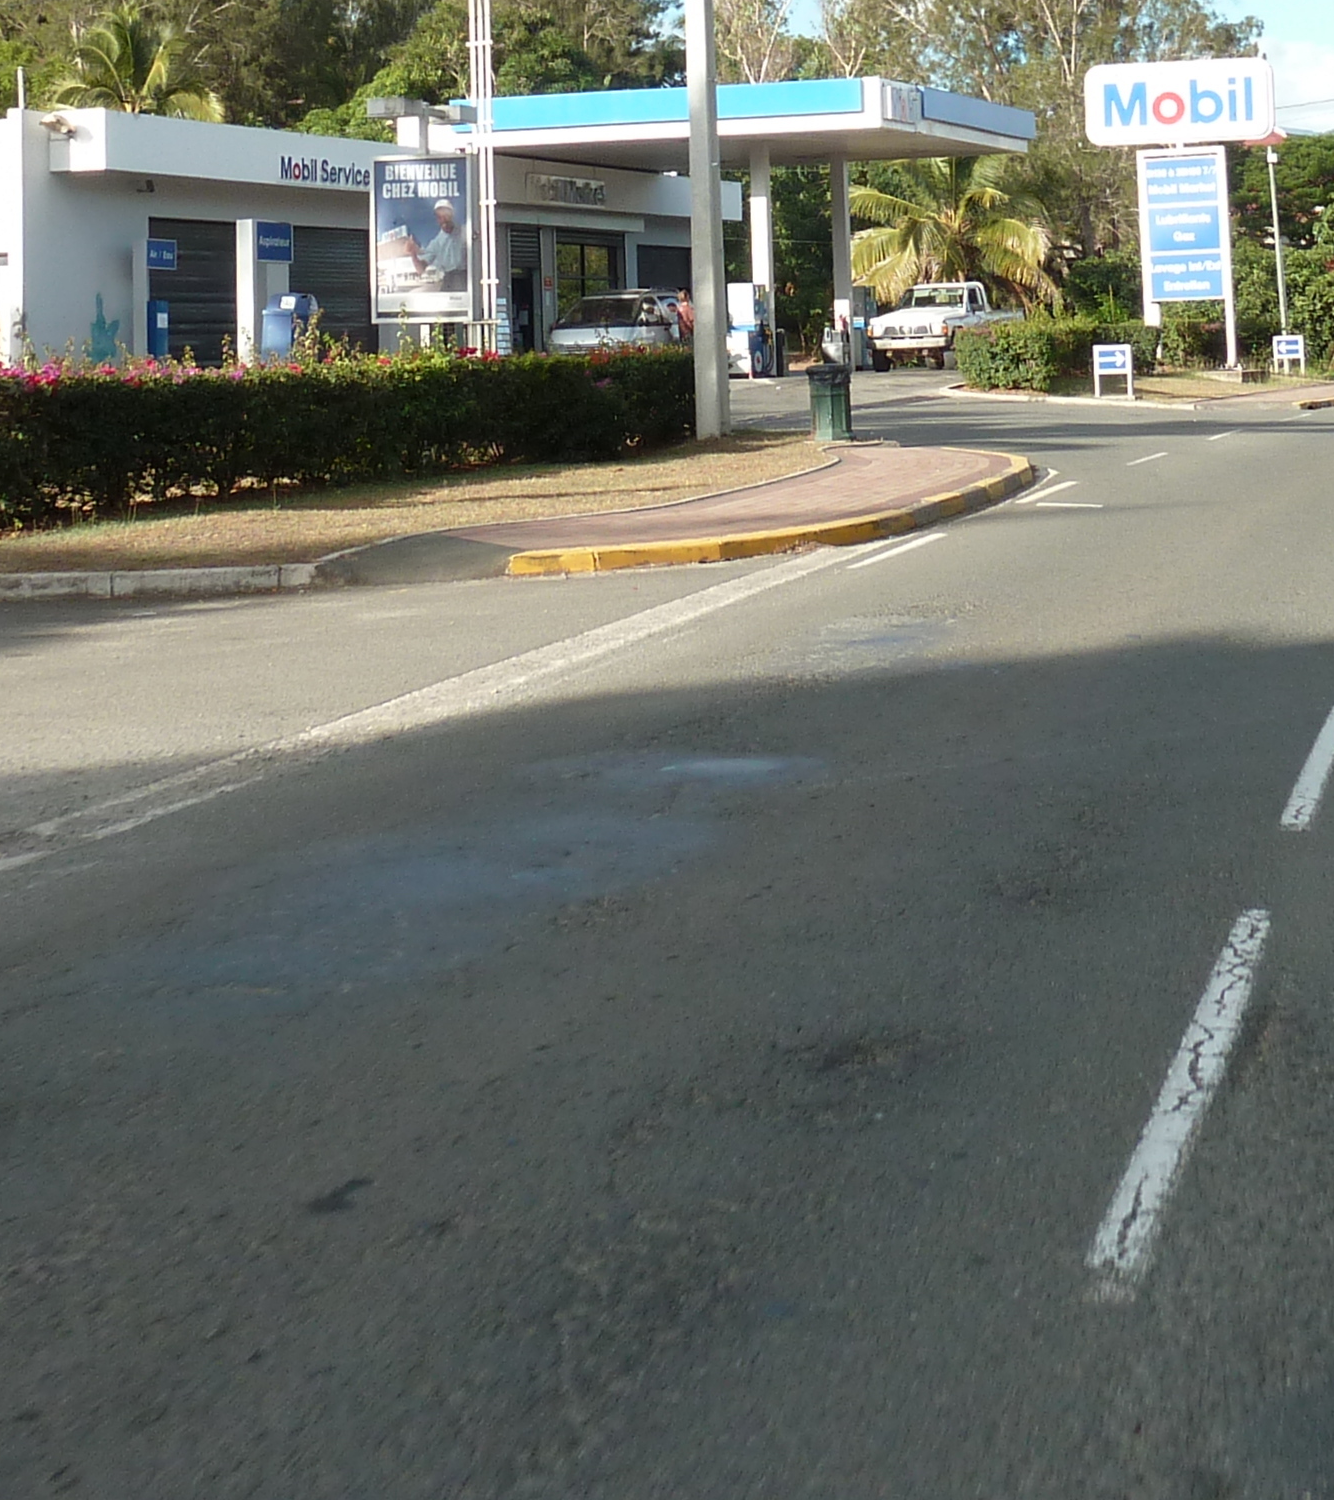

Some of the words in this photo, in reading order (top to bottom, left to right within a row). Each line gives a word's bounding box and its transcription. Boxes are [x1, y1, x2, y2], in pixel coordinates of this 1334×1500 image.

[1103, 77, 1253, 127] Mobil
[280, 156, 317, 181] Mobil
[321, 159, 370, 186] Service
[384, 163, 457, 181] BIENVENUE
[382, 181, 415, 199] CHEZ
[417, 181, 460, 198] MOBIL
[259, 235, 290, 248] Aspirateur
